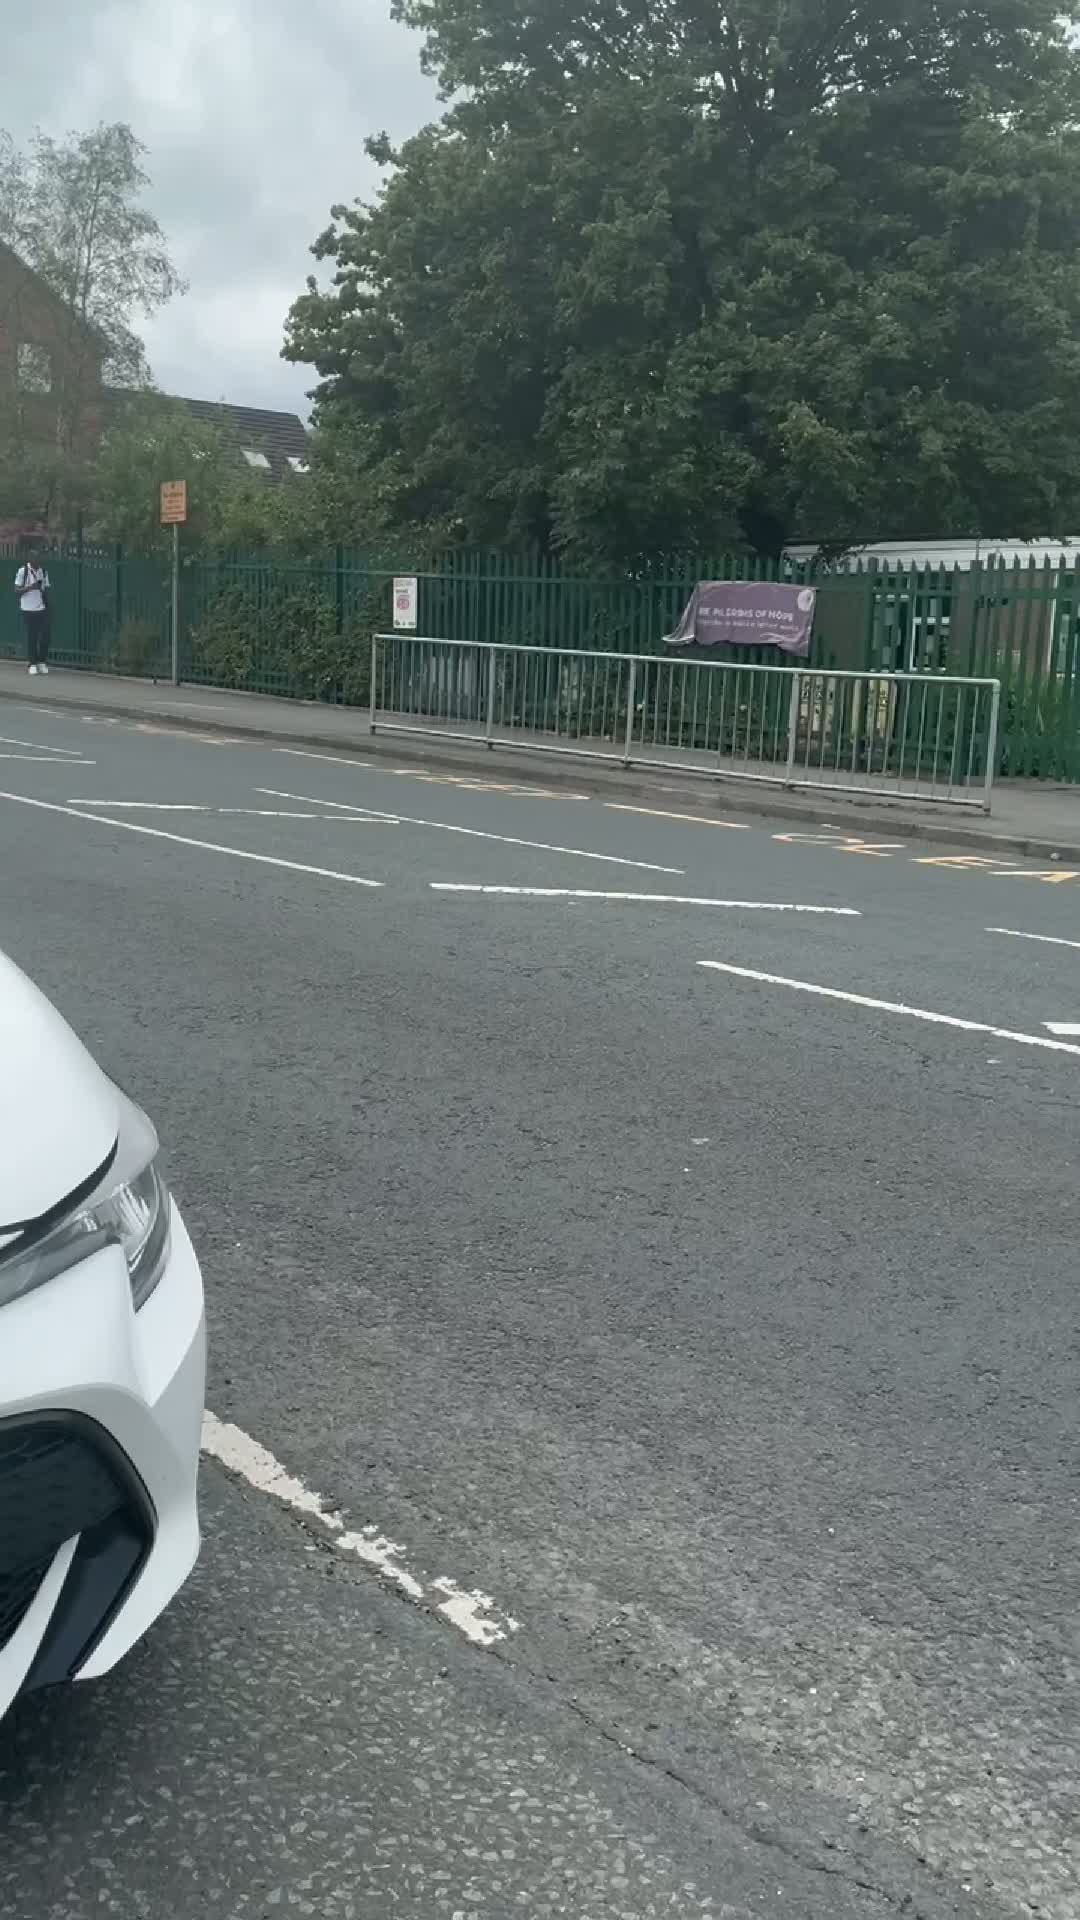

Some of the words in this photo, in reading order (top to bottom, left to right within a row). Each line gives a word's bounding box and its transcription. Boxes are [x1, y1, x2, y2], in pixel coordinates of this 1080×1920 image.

[712, 607, 753, 618] PILGRIMS
[755, 609, 766, 618] OF
[768, 610, 793, 622] HOPE
